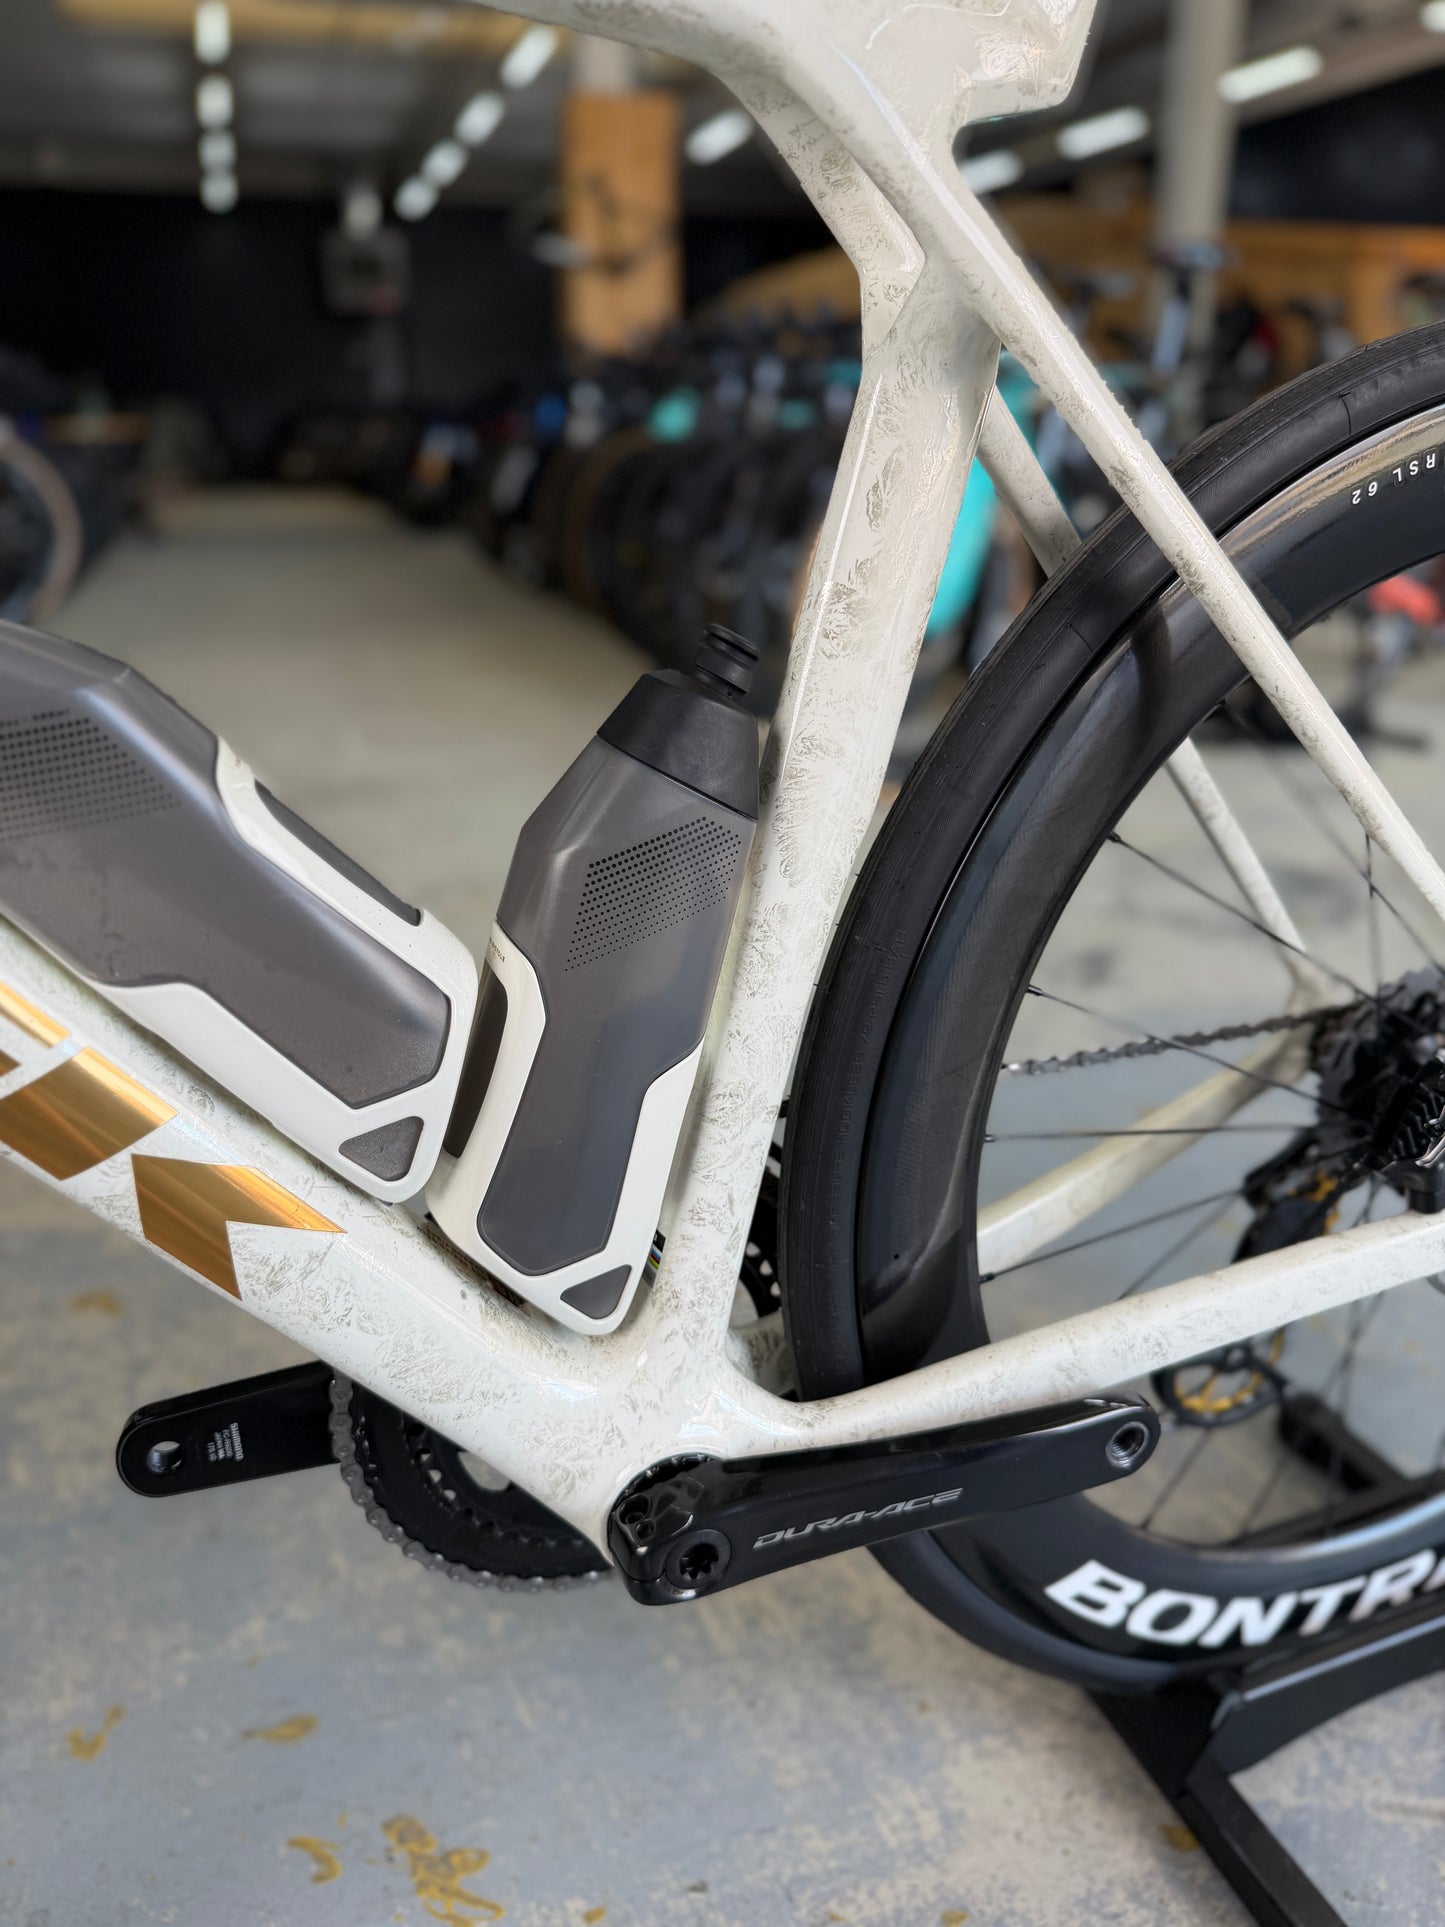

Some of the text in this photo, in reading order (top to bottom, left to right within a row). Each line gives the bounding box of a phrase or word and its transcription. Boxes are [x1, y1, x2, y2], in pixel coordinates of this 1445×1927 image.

[1352, 452, 1436, 505] RSL 62
[230, 1422, 244, 1461] SHIMANO
[752, 1487, 963, 1550] DURA-ACE
